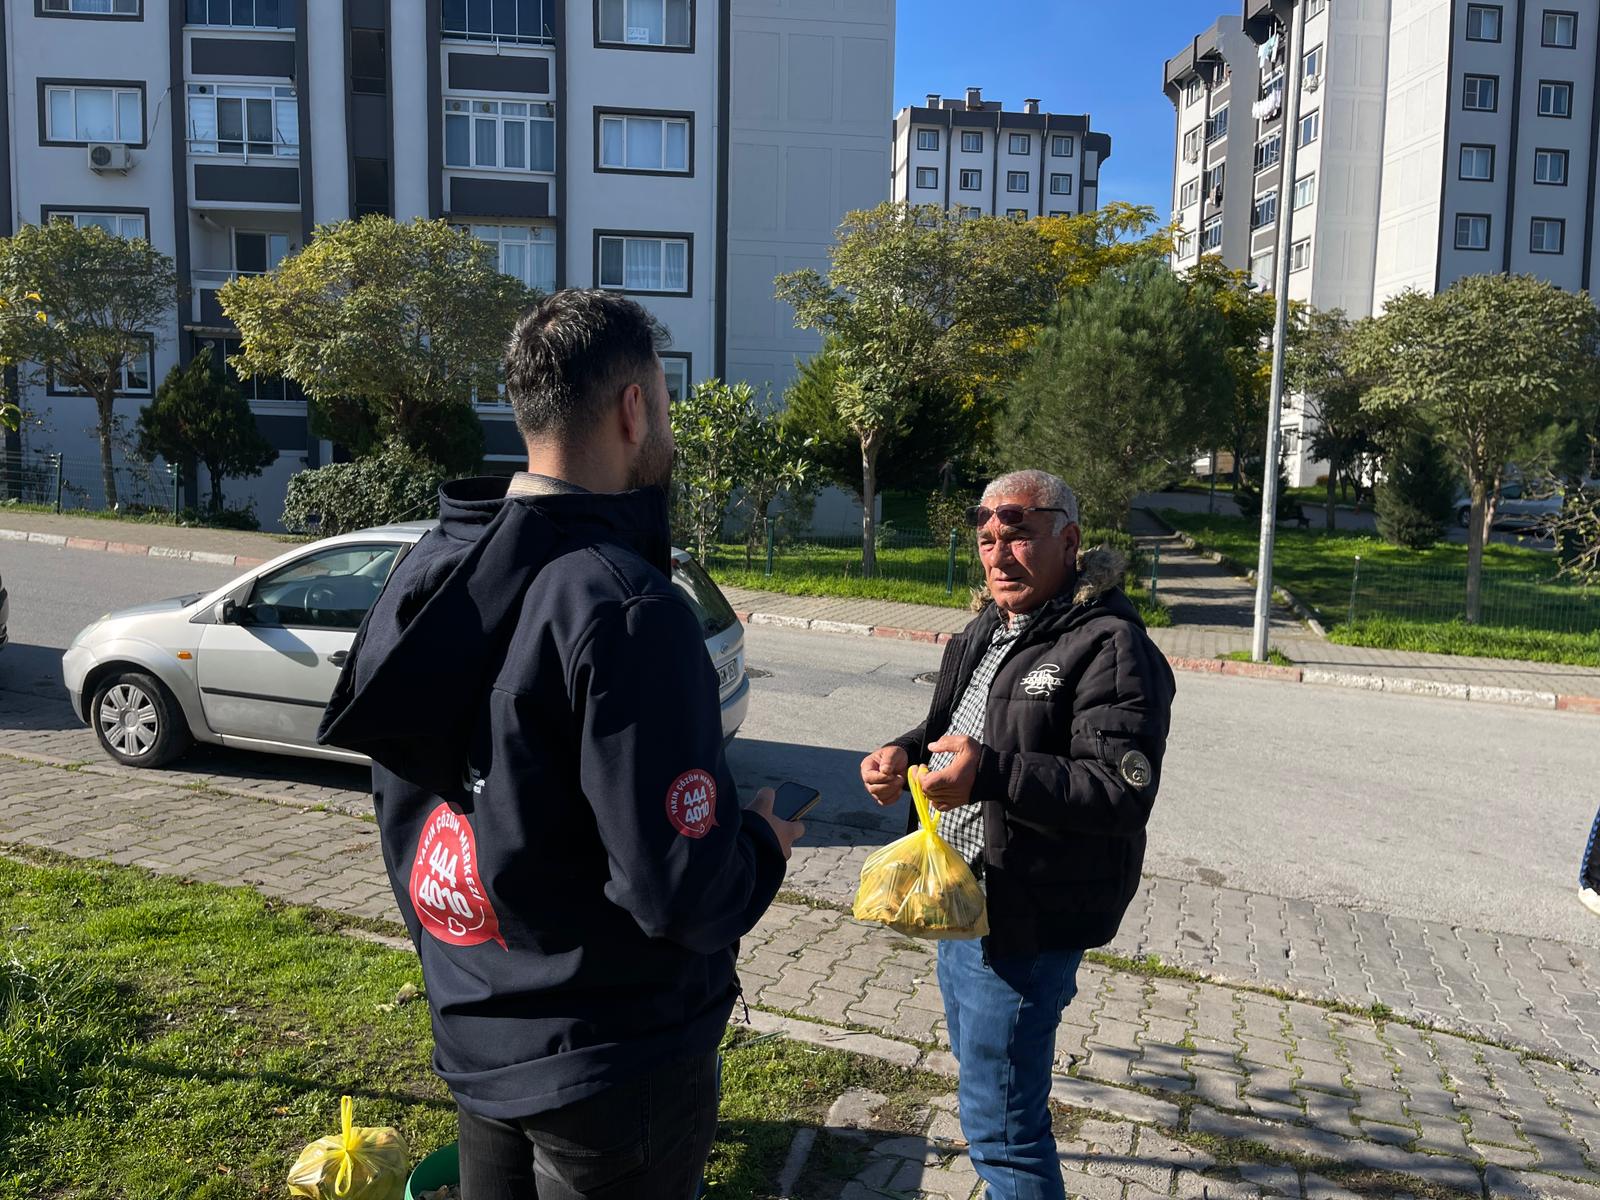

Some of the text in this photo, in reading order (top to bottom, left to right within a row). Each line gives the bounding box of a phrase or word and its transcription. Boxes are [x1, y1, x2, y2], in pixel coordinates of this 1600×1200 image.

[671, 791, 679, 815] YAKIN
[683, 785, 707, 806] 444
[685, 800, 710, 824] 4010
[417, 822, 436, 865] YAKIN
[436, 809, 460, 835] ÇÖZÜM
[428, 841, 459, 889] 444
[418, 874, 474, 919] 4010
